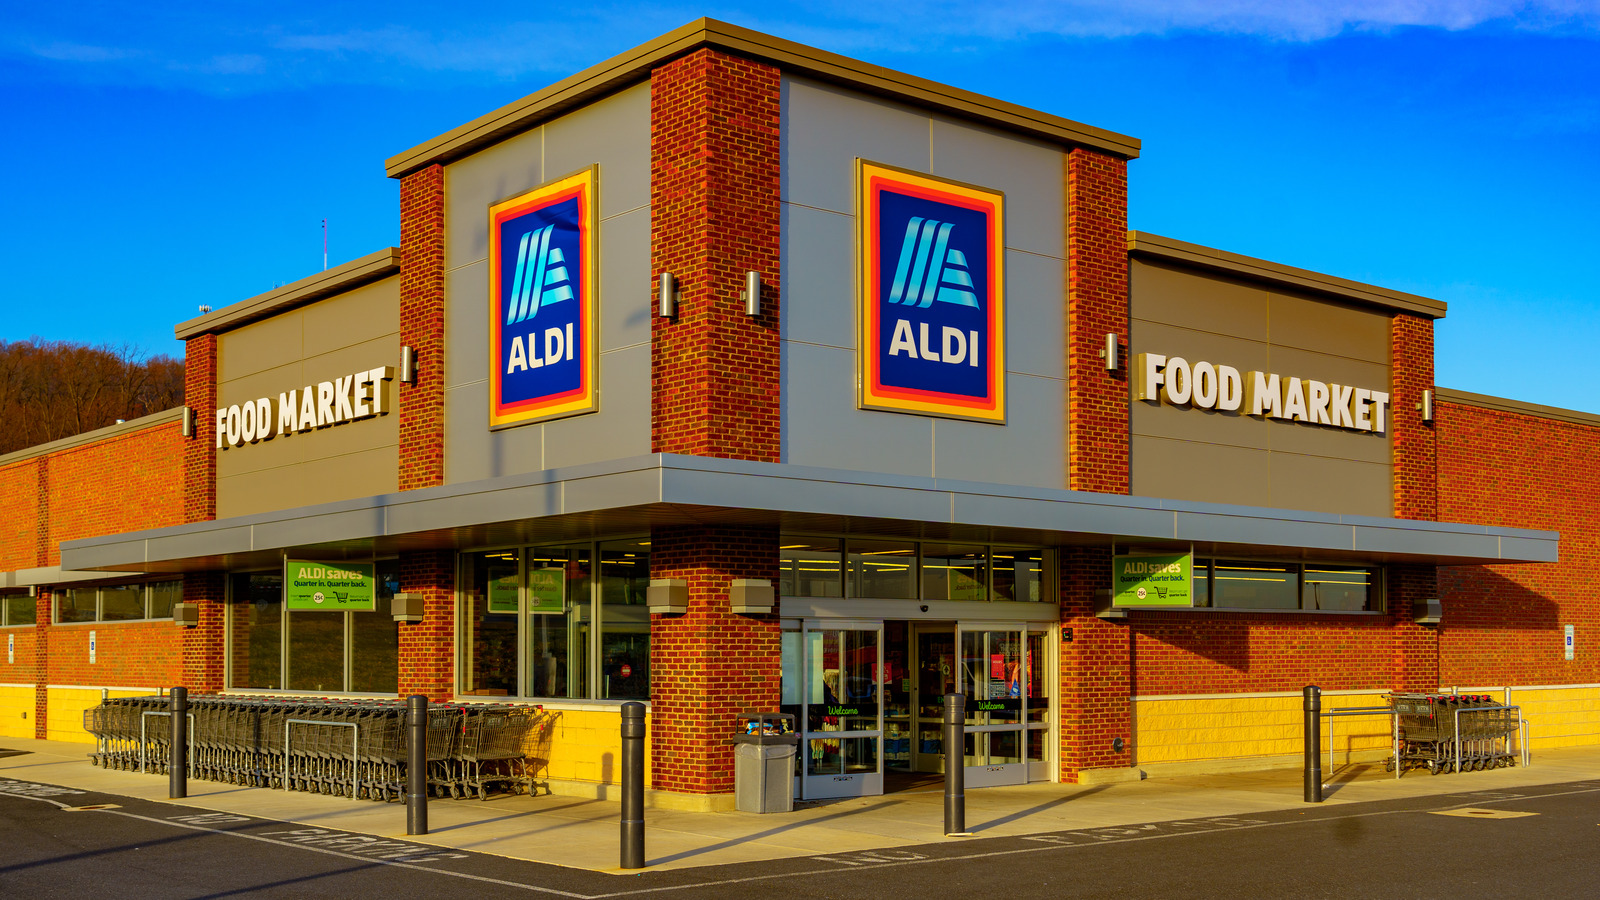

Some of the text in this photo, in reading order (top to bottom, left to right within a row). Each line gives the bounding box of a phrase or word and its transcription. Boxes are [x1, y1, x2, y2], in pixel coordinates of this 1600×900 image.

[507, 323, 574, 374] ALDI
[889, 318, 979, 367] ALDI
[1144, 353, 1389, 433] FOOD MARKET
[216, 366, 389, 449] FOOD MARKET
[298, 568, 363, 579] ALDI saves
[1124, 562, 1181, 574] ALDI saves
[827, 706, 859, 715] Welcome
[977, 701, 1005, 710] Welcome
[166, 812, 251, 825] NO
[258, 828, 470, 863] PARKING
